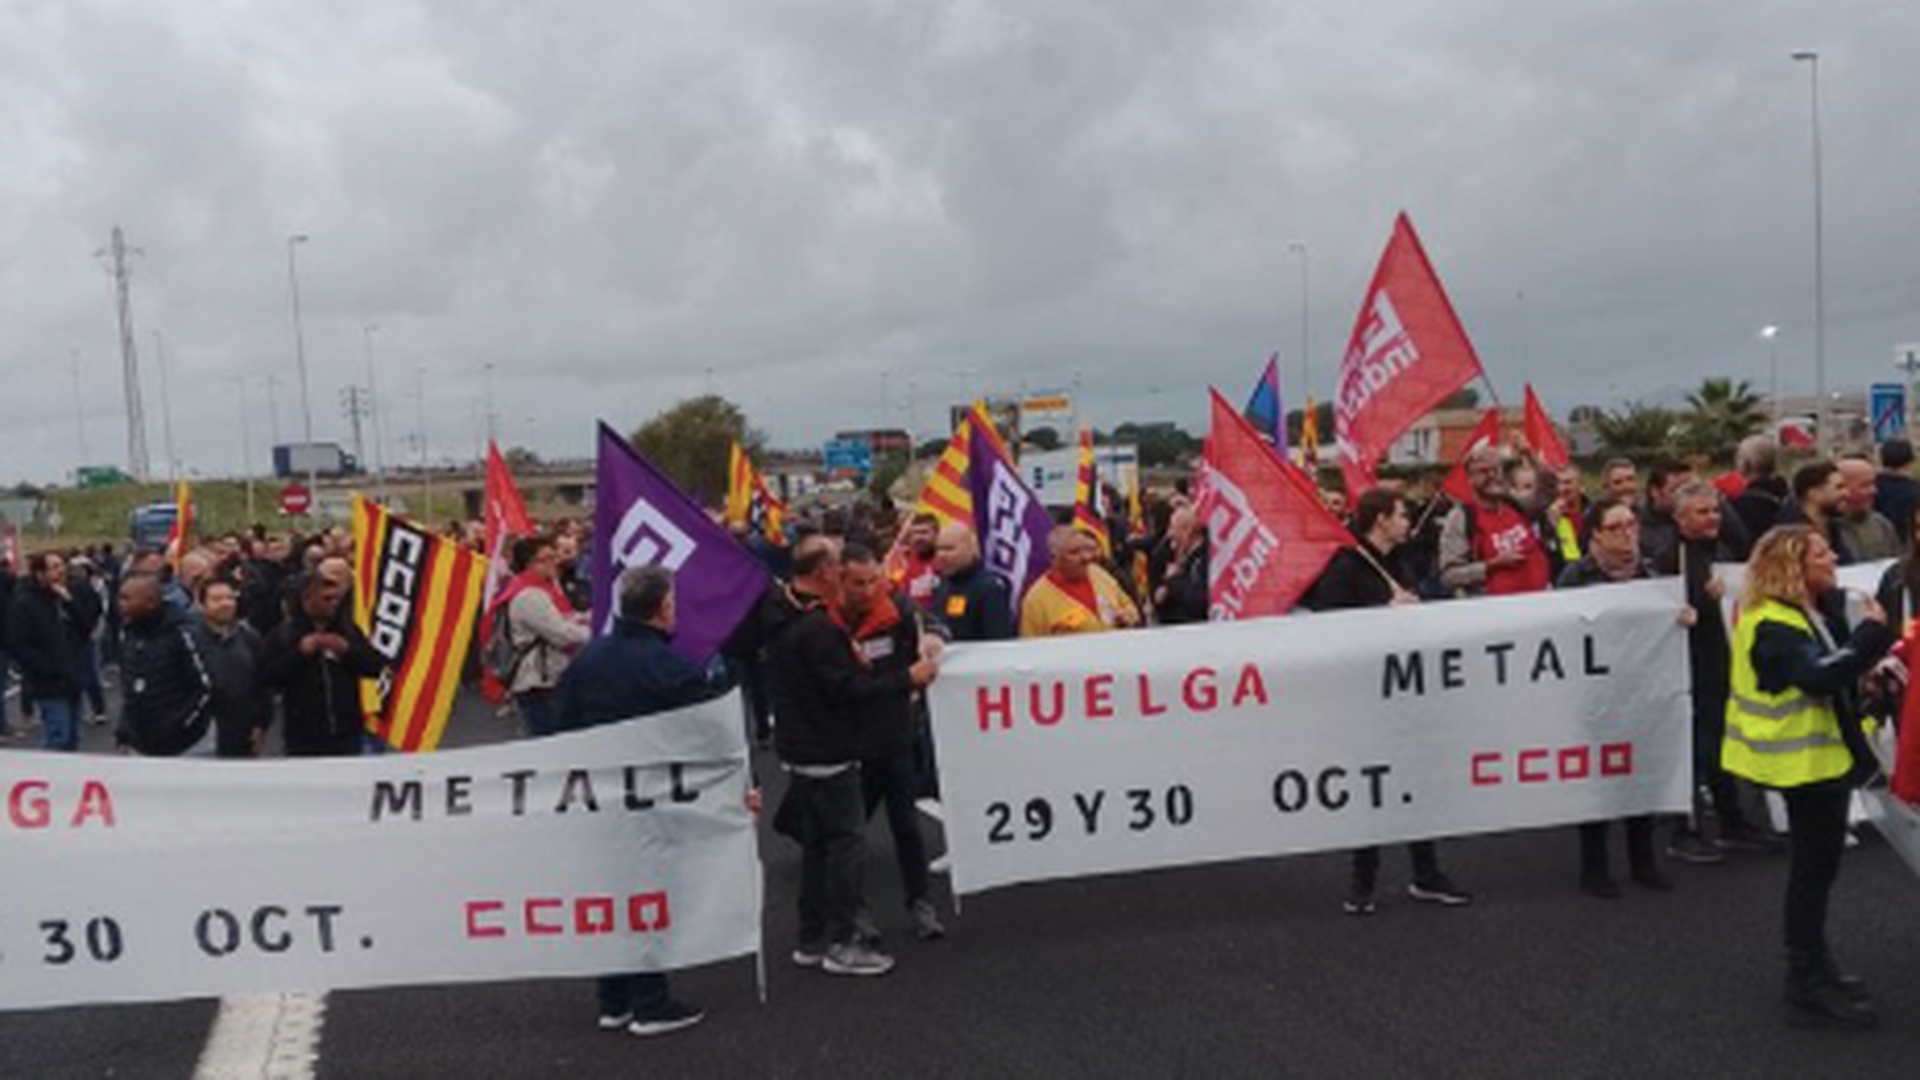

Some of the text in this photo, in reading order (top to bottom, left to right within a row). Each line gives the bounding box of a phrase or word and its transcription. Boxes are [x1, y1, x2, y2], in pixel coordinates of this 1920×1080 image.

[370, 527, 423, 659] CCOO
[975, 633, 1611, 733] HUELGA METAL
[370, 762, 698, 821] METALL
[985, 742, 1635, 845] 29 Y 30 OCT. CCOO
[39, 890, 672, 965] 30 OCT. CCOO
